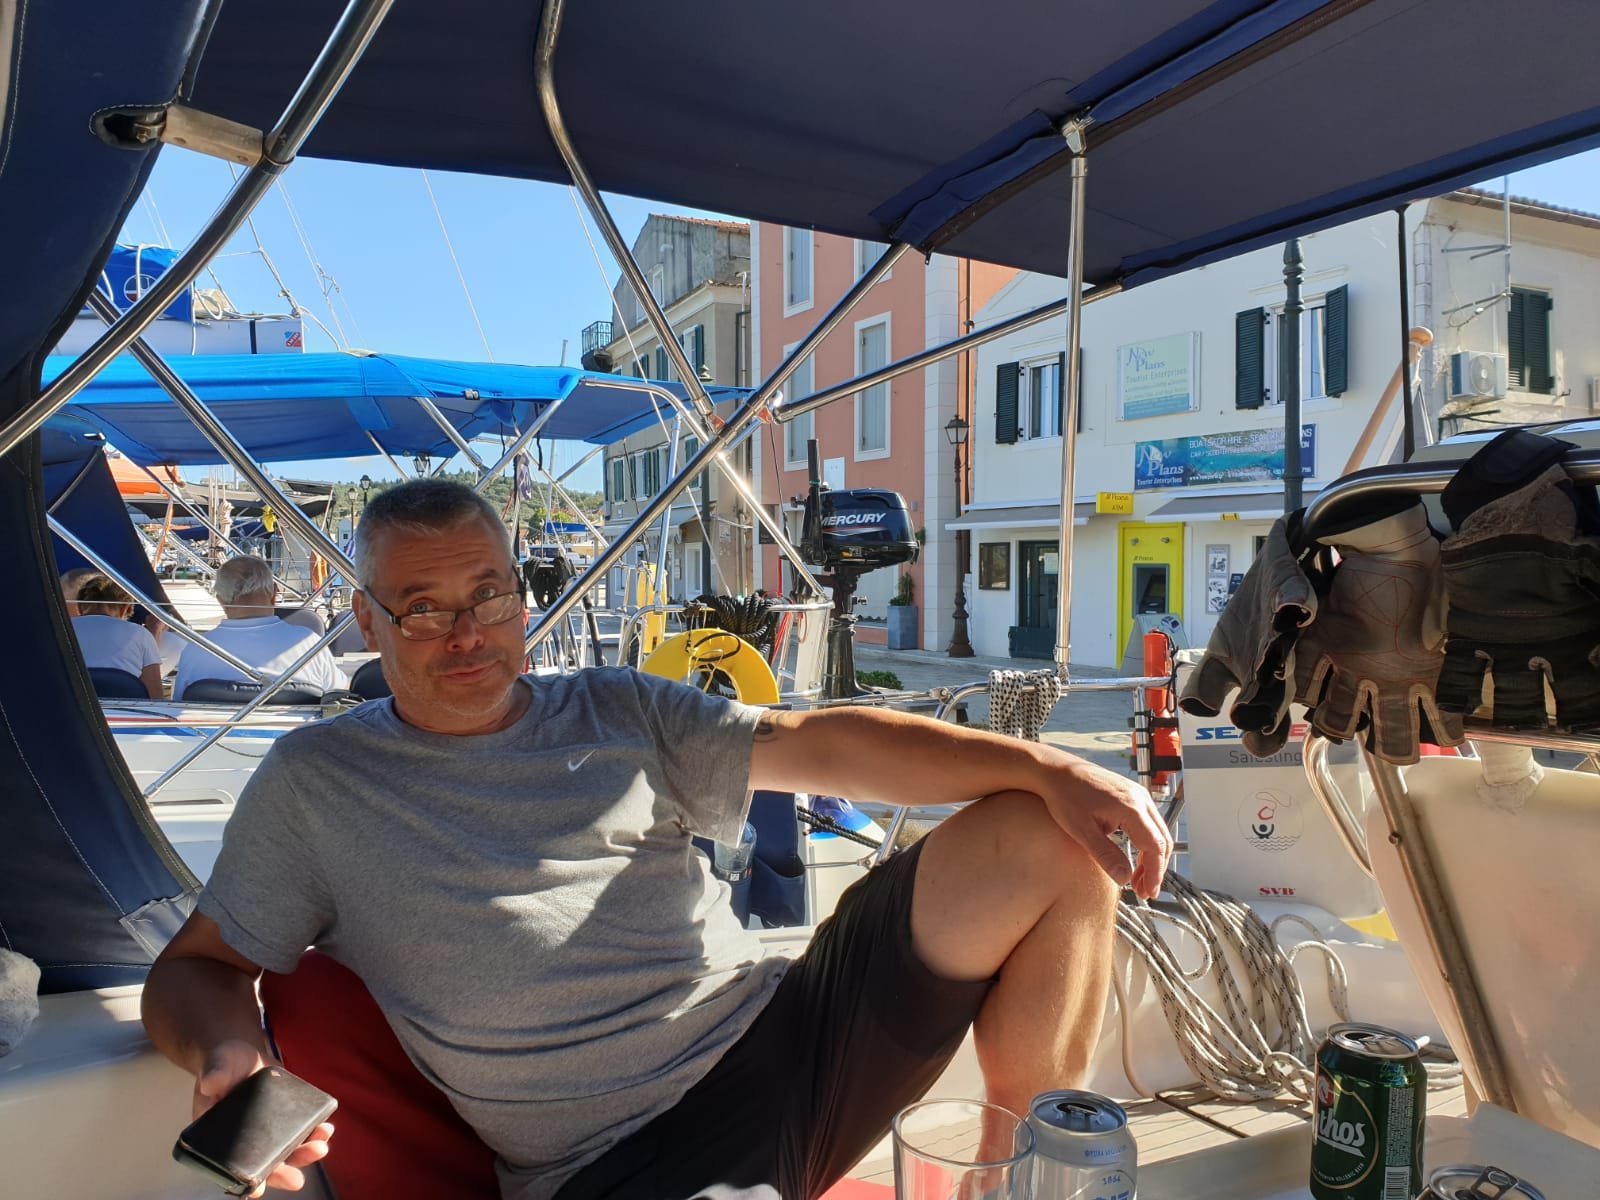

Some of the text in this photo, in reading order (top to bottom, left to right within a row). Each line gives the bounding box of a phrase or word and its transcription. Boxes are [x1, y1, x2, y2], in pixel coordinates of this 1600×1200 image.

[1146, 460, 1184, 477] Plans
[1259, 887, 1296, 896] SVB
[1317, 1107, 1367, 1148] thos
